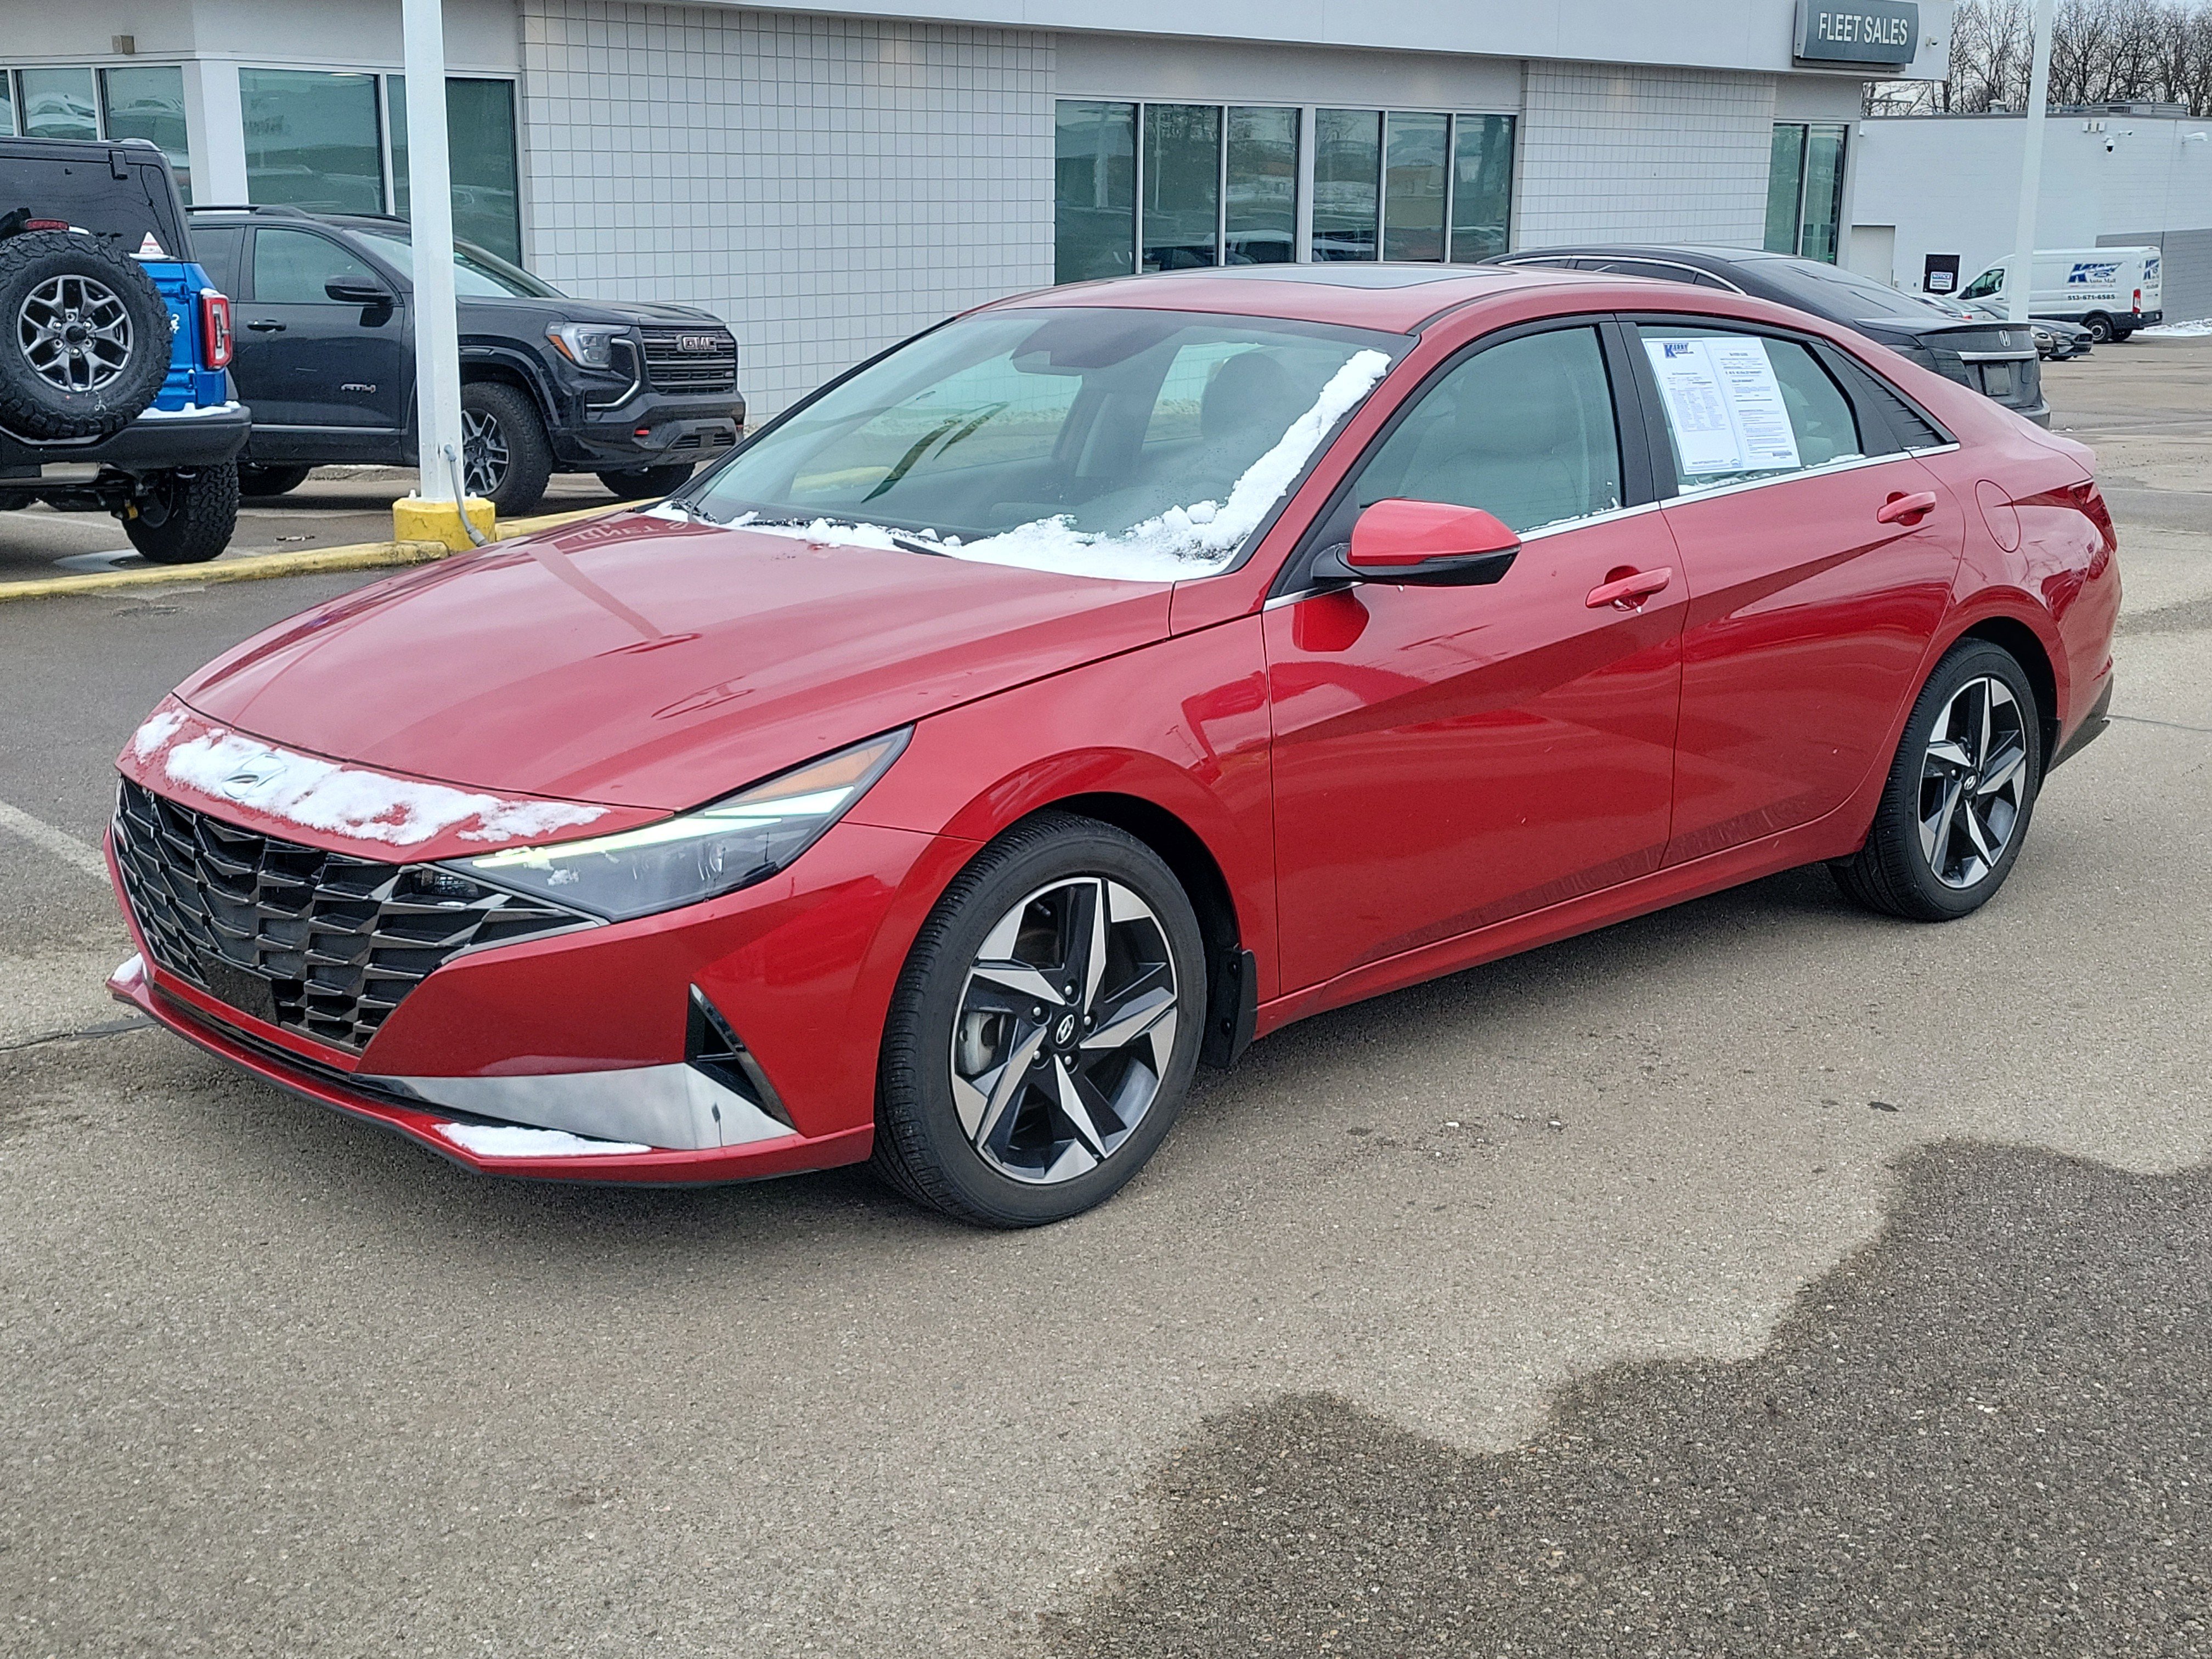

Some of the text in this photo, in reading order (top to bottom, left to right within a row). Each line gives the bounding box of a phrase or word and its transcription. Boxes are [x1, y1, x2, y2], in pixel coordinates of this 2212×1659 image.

[1818, 13, 1908, 46] FLEET SALES
[682, 337, 716, 351] GMC
